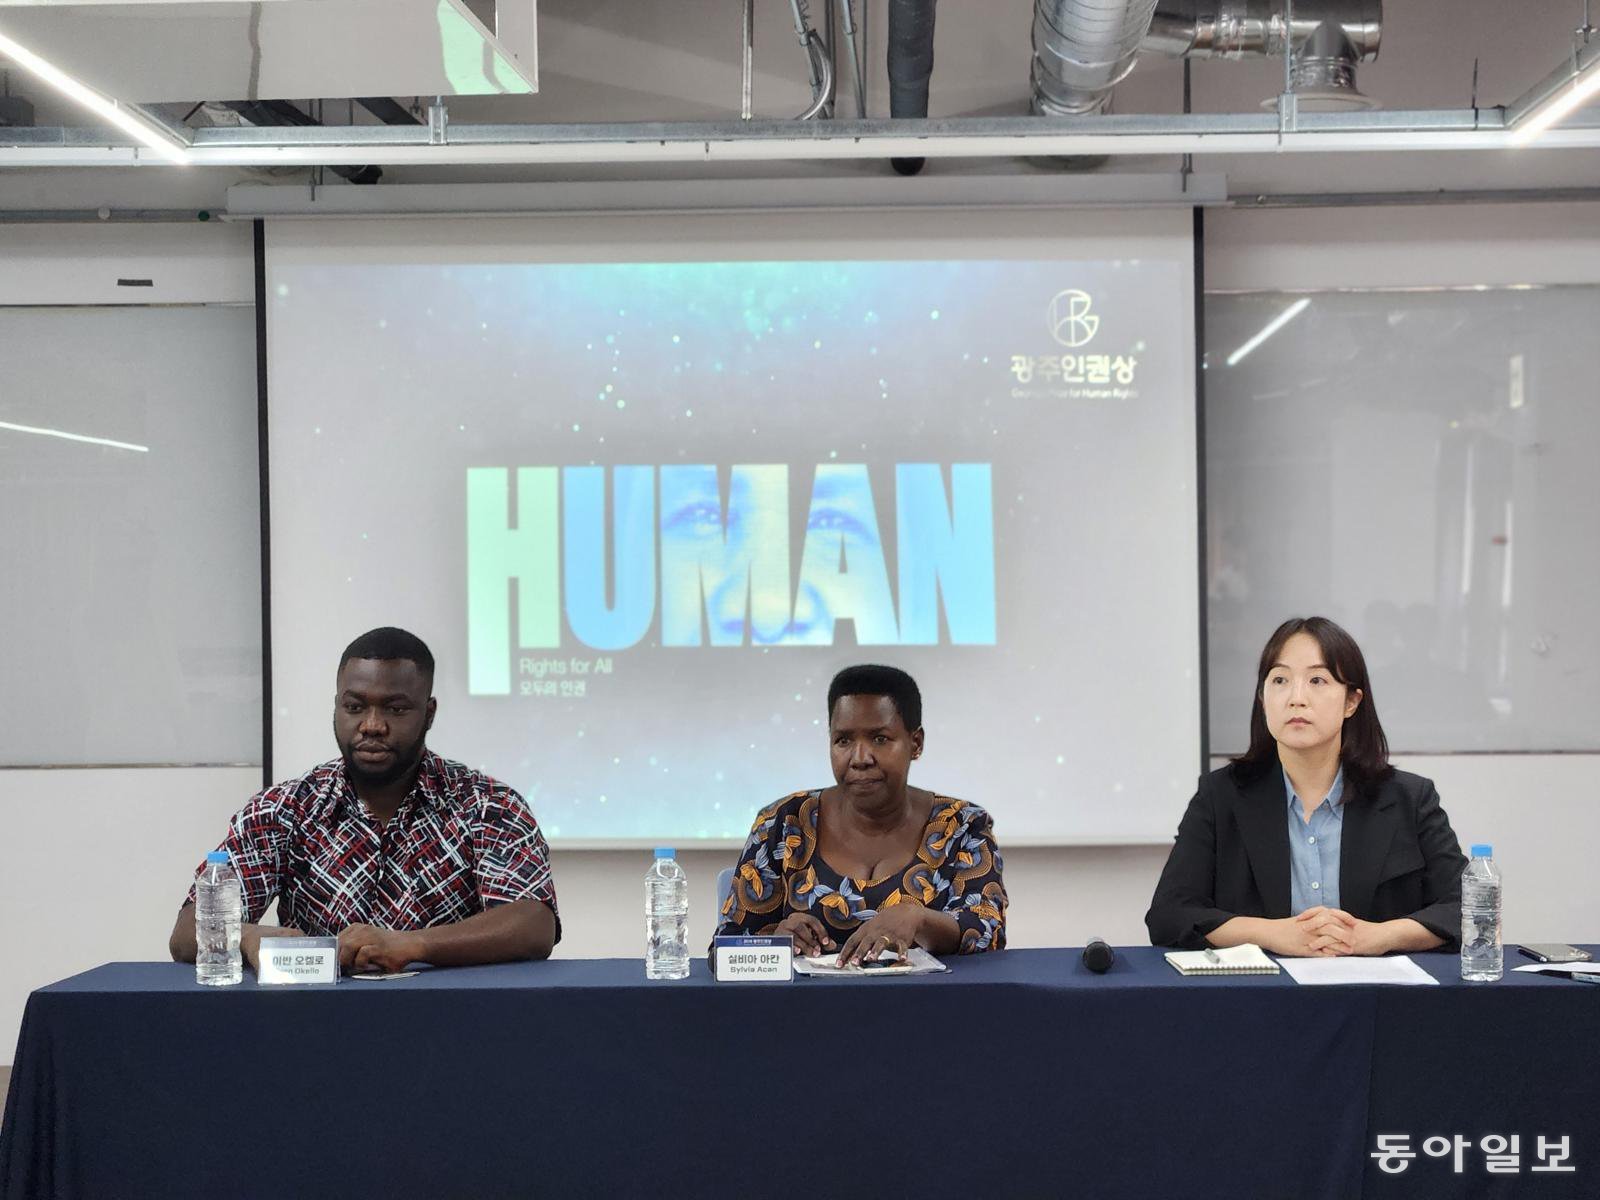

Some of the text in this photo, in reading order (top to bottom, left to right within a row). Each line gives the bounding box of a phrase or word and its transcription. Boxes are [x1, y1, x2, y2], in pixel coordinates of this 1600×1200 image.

[1010, 354, 1138, 385] 광주인권상
[1082, 387, 1112, 398] Human
[1113, 387, 1139, 400] Righ
[466, 463, 998, 695] HUMAN
[519, 657, 613, 678] Rights for All
[272, 955, 325, 966] 이반 오켈로
[728, 954, 780, 965] 실비아 아칸
[730, 966, 778, 975] Sylvia Acan
